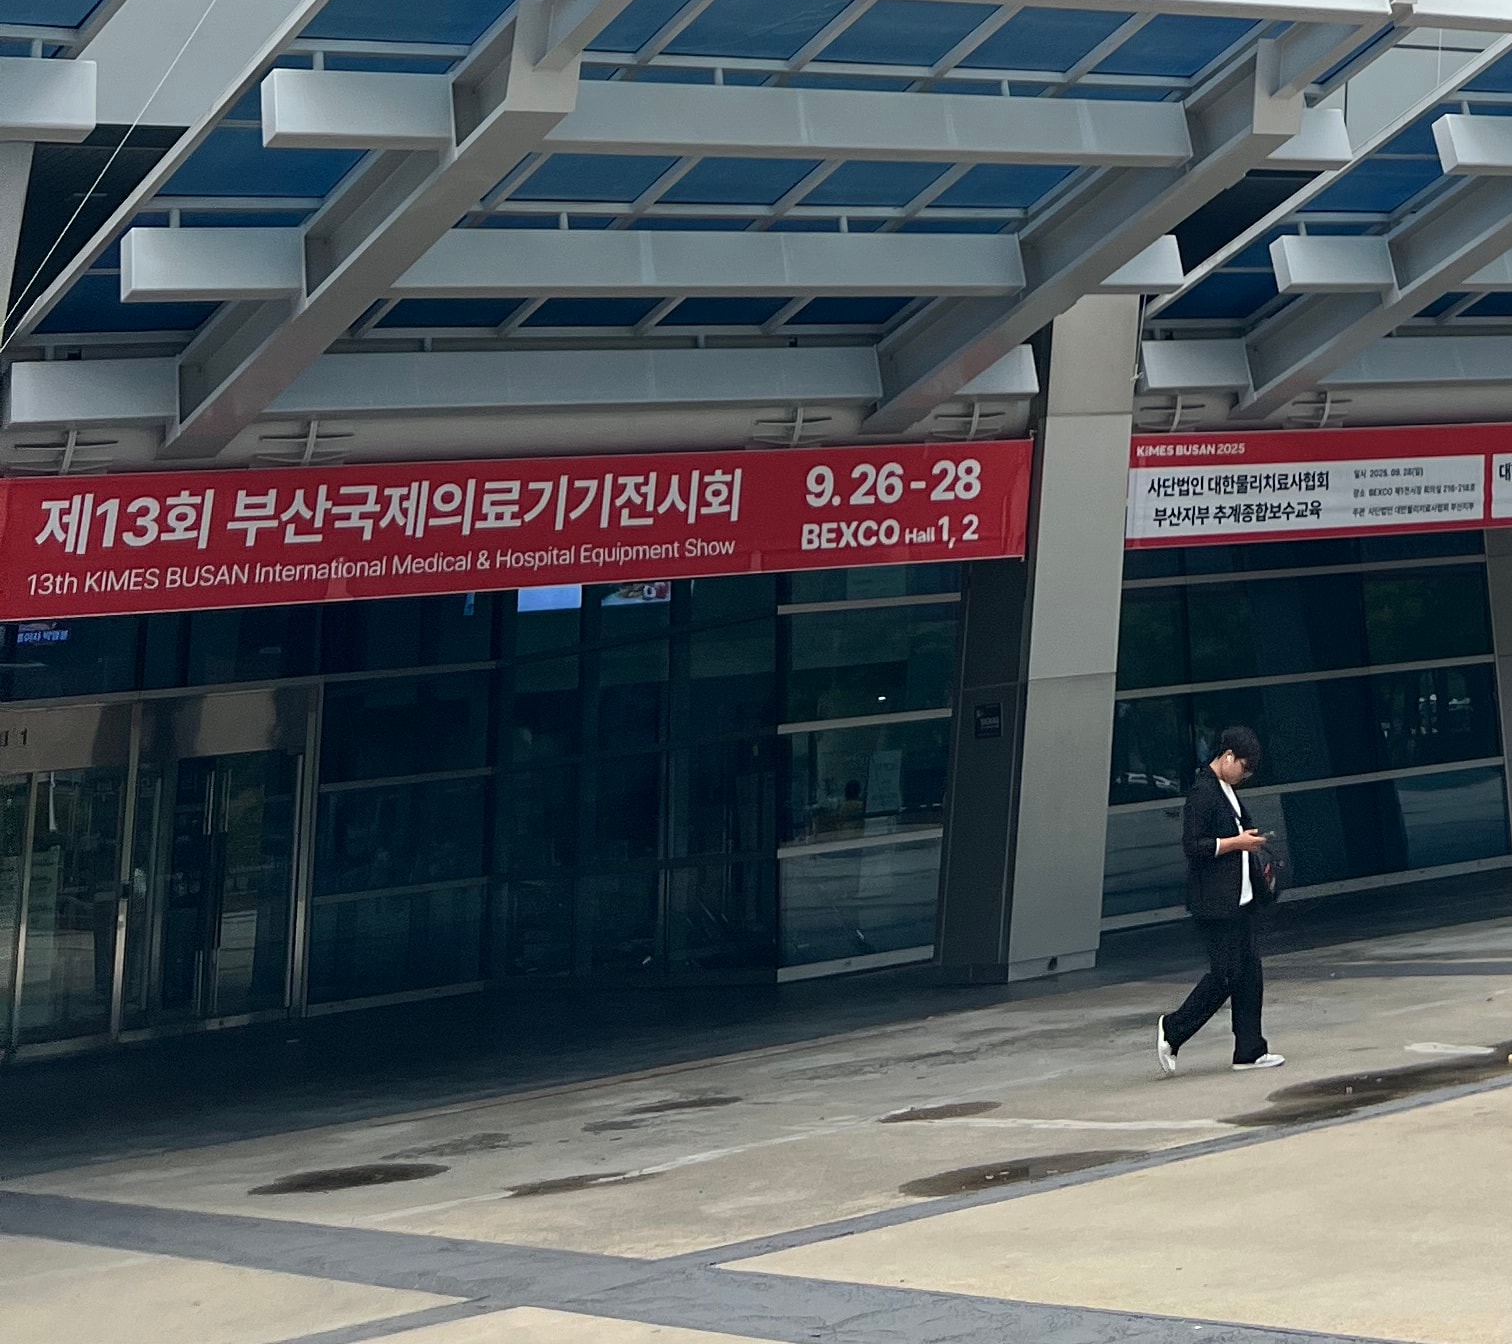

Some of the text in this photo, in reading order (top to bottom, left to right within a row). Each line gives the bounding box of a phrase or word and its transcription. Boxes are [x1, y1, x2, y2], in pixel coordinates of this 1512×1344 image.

[1176, 443, 1215, 456] BUSAN
[1216, 442, 1245, 455] 2025
[1148, 470, 1330, 497] 사단법인 대한물리치료사협회
[36, 468, 742, 555] 제13회 부산국제의료기기전시회
[1153, 499, 1323, 528] 부산지부 추계종합보수교육
[800, 520, 900, 551] BEXCO
[904, 527, 936, 545] Hall
[27, 537, 735, 596] 13th KIMES BUSAN International Medical & Hospital Equipment Show
